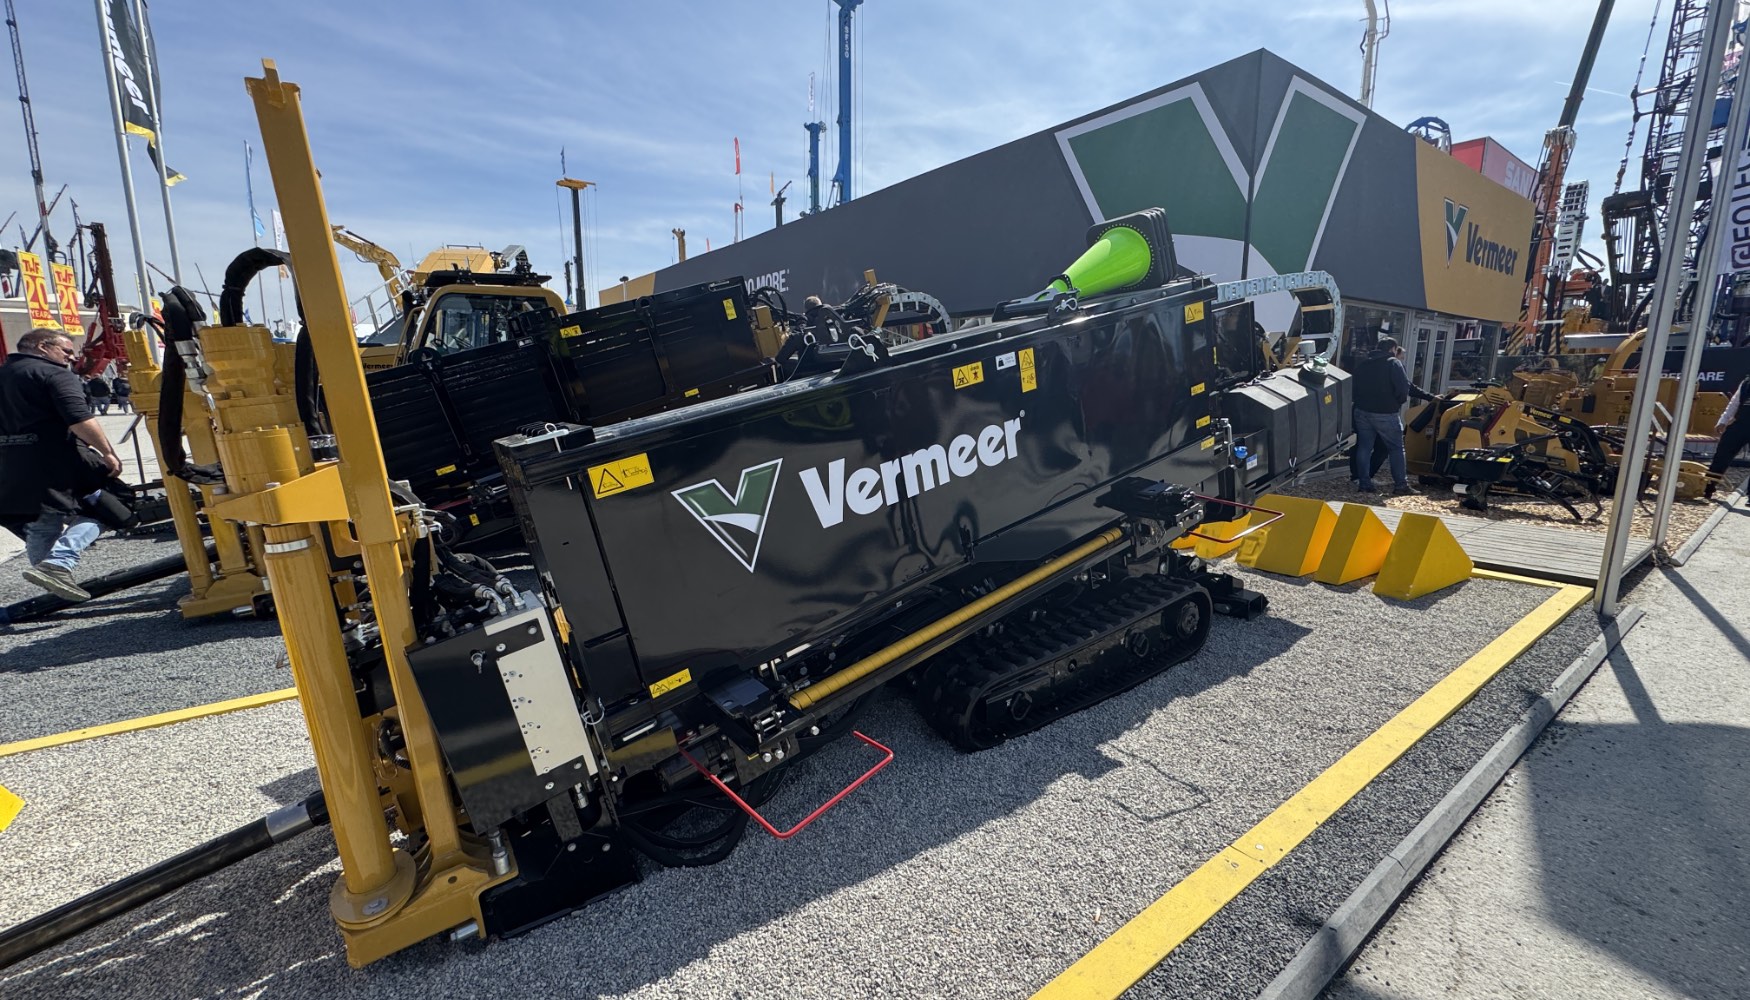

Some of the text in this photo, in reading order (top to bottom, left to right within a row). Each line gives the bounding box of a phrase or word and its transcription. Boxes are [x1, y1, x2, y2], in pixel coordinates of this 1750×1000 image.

[1466, 222, 1518, 276] Vermeer
[22, 257, 40, 274] TWF
[55, 269, 73, 284] TWF
[26, 276, 49, 310] 20
[58, 286, 78, 315] 20
[799, 417, 1021, 528] Vermeer
